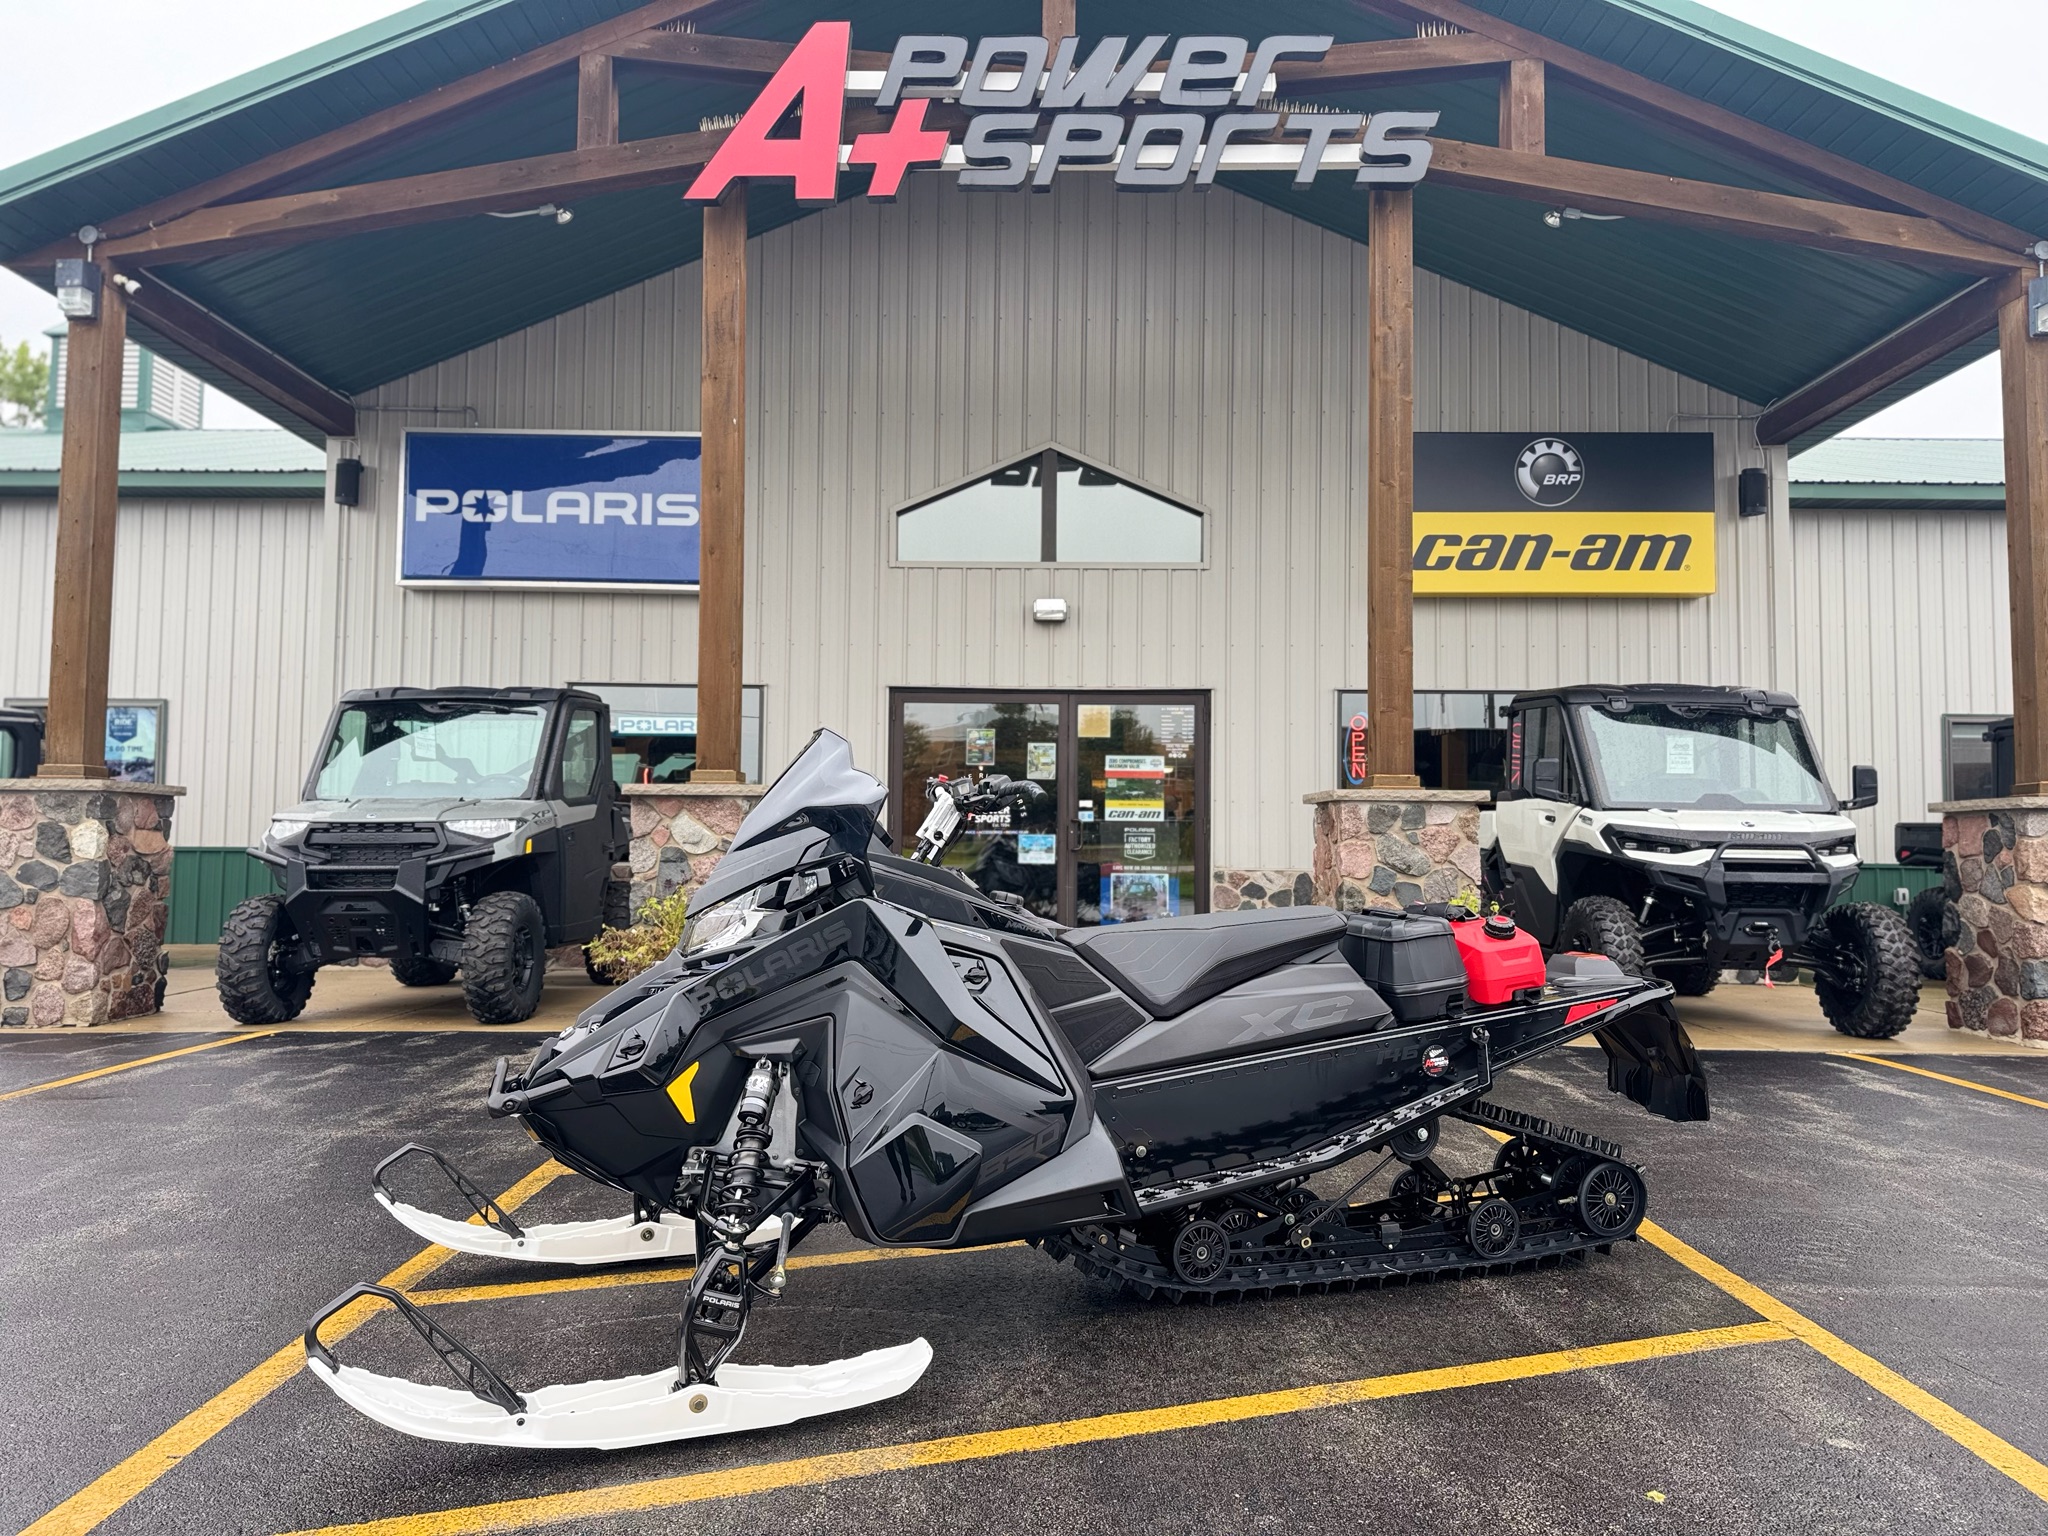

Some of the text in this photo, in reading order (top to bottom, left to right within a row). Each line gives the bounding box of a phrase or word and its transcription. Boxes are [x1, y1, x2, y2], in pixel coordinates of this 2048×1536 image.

[683, 20, 951, 201] A+
[1543, 473, 1581, 486] BRP
[415, 488, 700, 527] POLARIS
[1350, 715, 1367, 779] OPEN
[531, 809, 551, 821] XP
[975, 814, 1011, 823] SPORTS
[1108, 810, 1161, 818] can-am
[685, 919, 853, 1017] POLARIS
[1227, 994, 1355, 1045] XC
[702, 1295, 741, 1309] POLARIS
